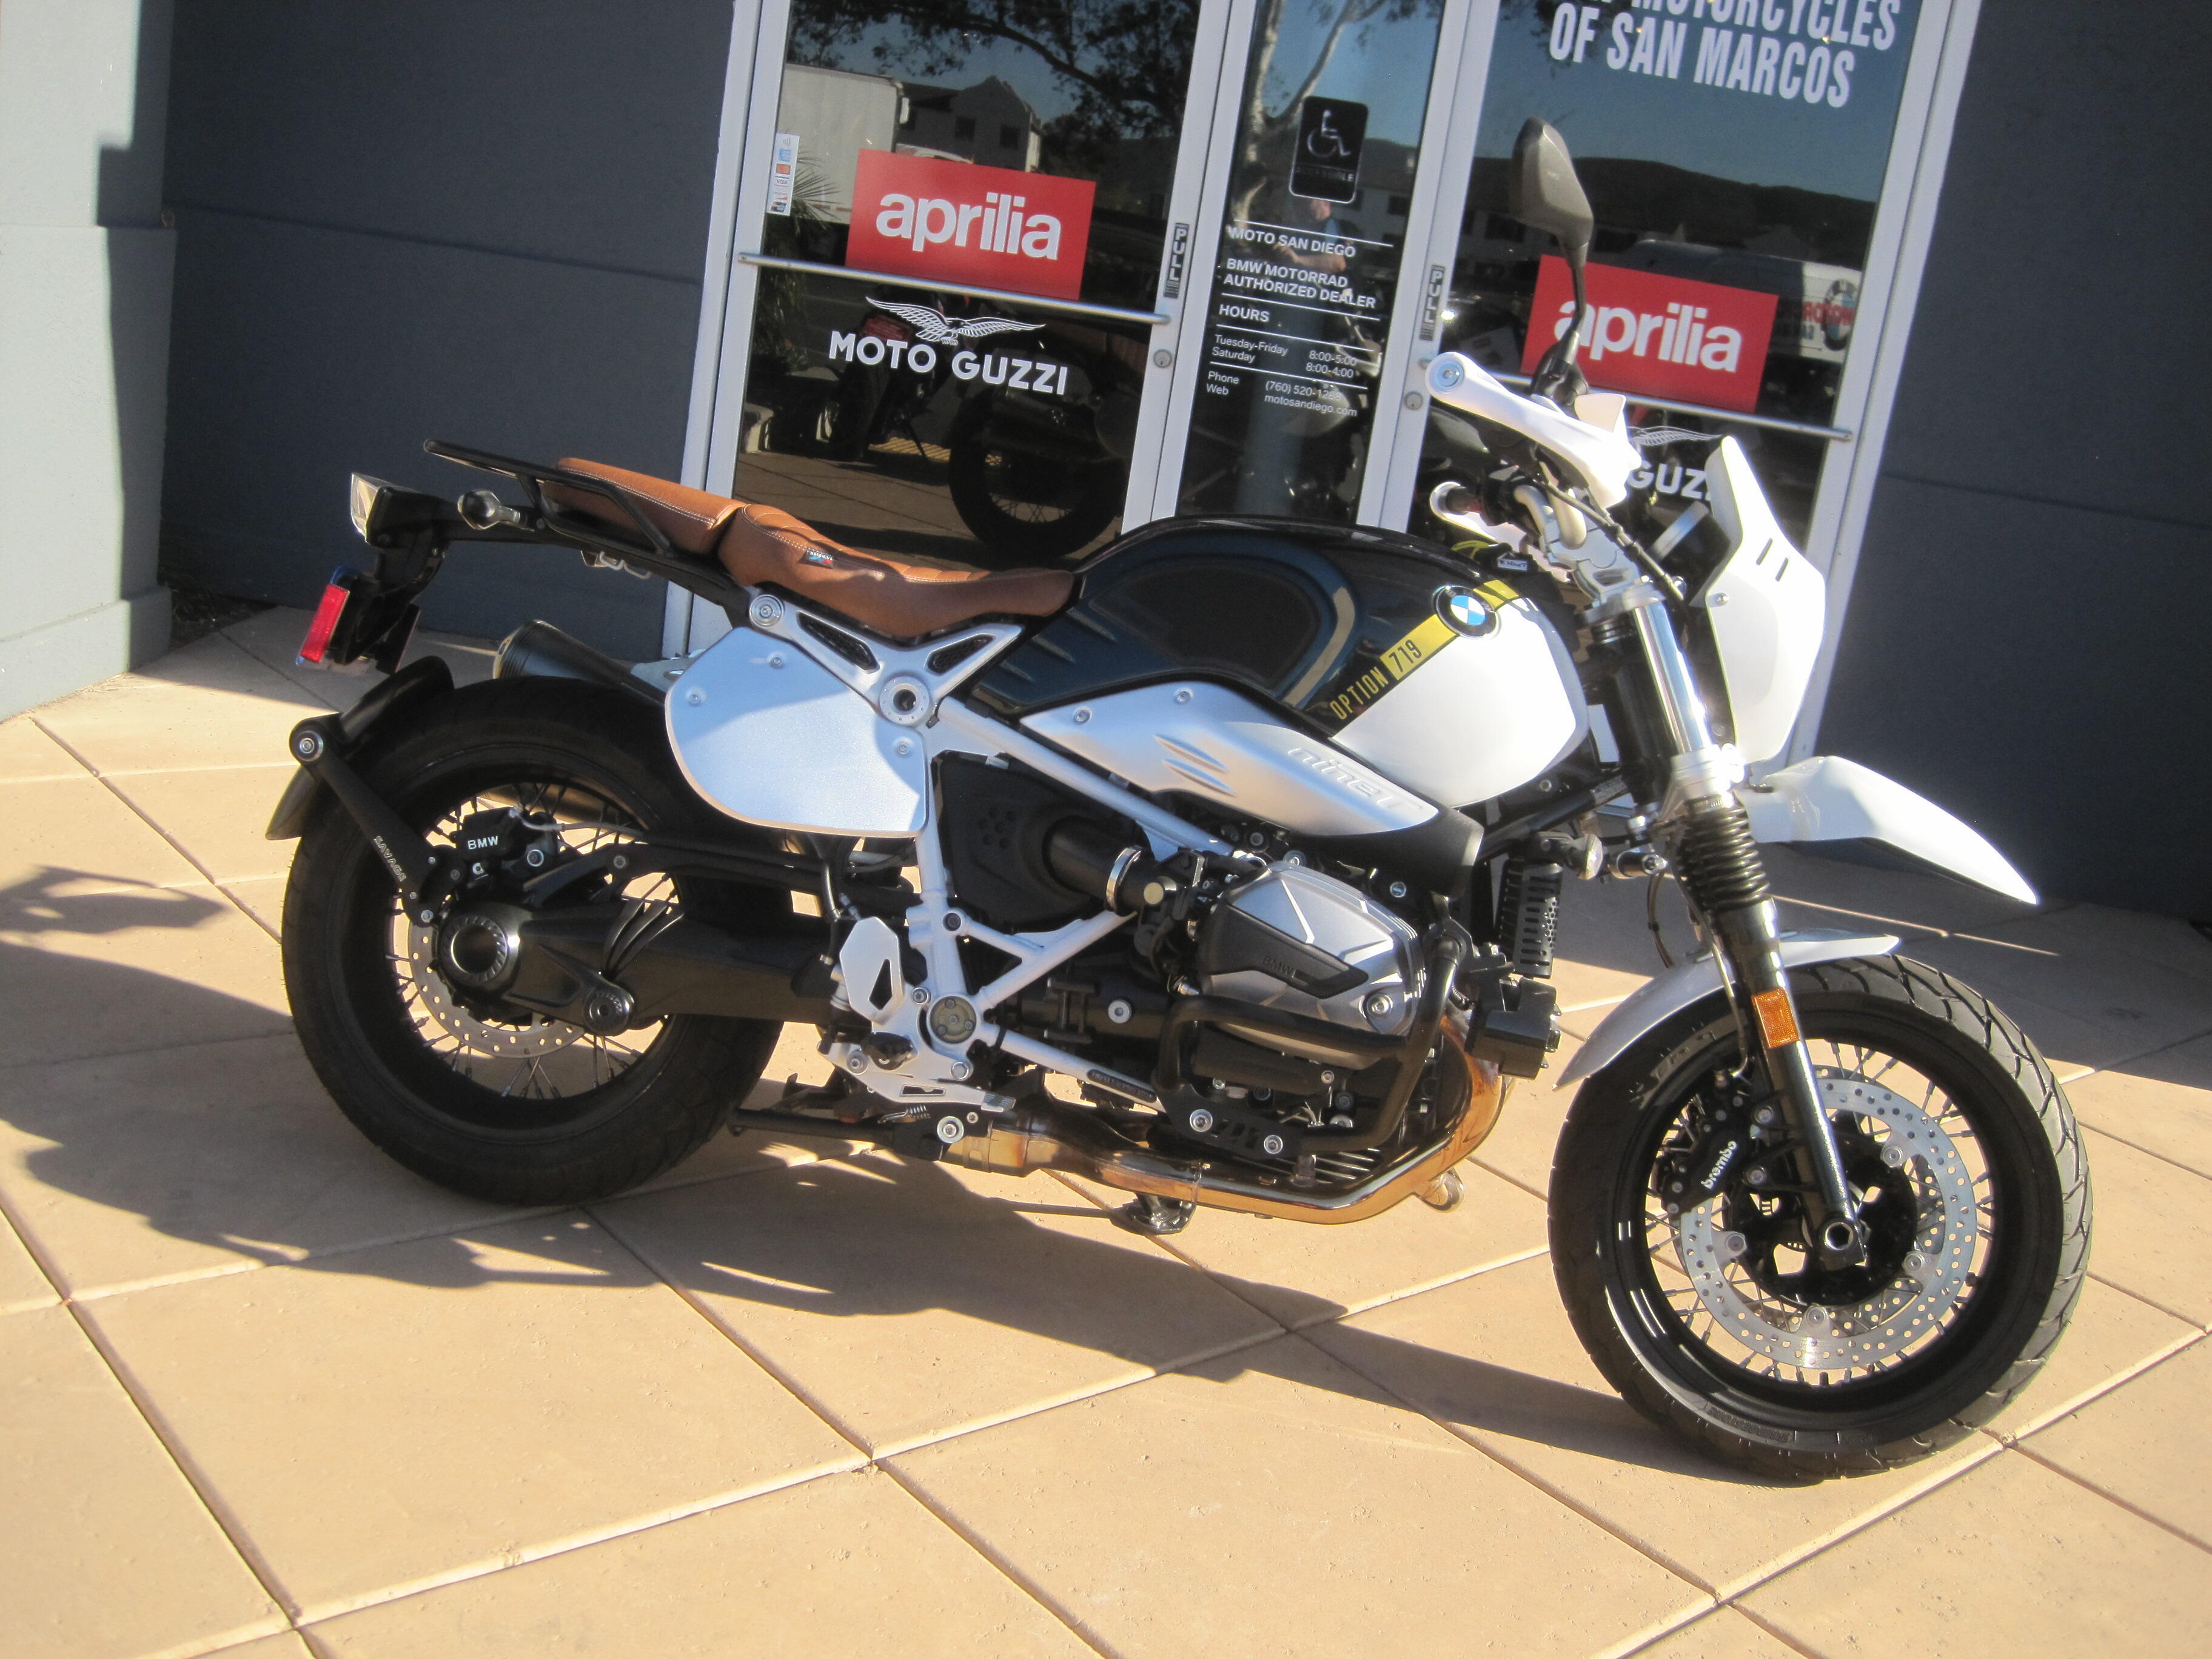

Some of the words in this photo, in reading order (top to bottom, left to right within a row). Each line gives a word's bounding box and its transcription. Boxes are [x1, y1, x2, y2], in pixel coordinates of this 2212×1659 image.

[1631, 0, 1900, 50] CYCLES
[1549, 2, 1600, 62] OF
[1606, 12, 1687, 79] SAN
[1694, 27, 1855, 108] MARCOS
[876, 192, 1062, 260] aprilia
[1229, 227, 1275, 244] MOTO
[1278, 234, 1308, 250] SAN
[1311, 240, 1356, 257] DIEGO
[1169, 228, 1187, 281] PULL
[1227, 258, 1262, 274] BMW
[1264, 264, 1348, 288] MOTORRAD
[1223, 273, 1316, 298] AUTHORIZED
[1319, 289, 1376, 309] DEALER
[1424, 270, 1443, 323] PULL
[1219, 304, 1270, 323] HOURS
[1215, 334, 1289, 357] Tuesday-Friday
[1309, 350, 1357, 366] 8:00-5:00
[1553, 301, 1742, 373] aprilia
[829, 330, 937, 374] MOTO
[951, 350, 1068, 395] GUZZI
[1208, 370, 1240, 384] Phone
[1265, 381, 1292, 394] (760)
[1212, 346, 1256, 363] Saturday
[1305, 362, 1354, 378] 8:00-4:00
[1206, 383, 1229, 395] Web
[1264, 394, 1358, 417] motosandiego.com
[1627, 460, 1711, 501] GUZ
[1330, 666, 1389, 720] OPTION
[1388, 639, 1422, 673] 719
[373, 835, 407, 882] SAVAGE
[468, 835, 498, 850] BMW
[1701, 1141, 1738, 1189] brembo
